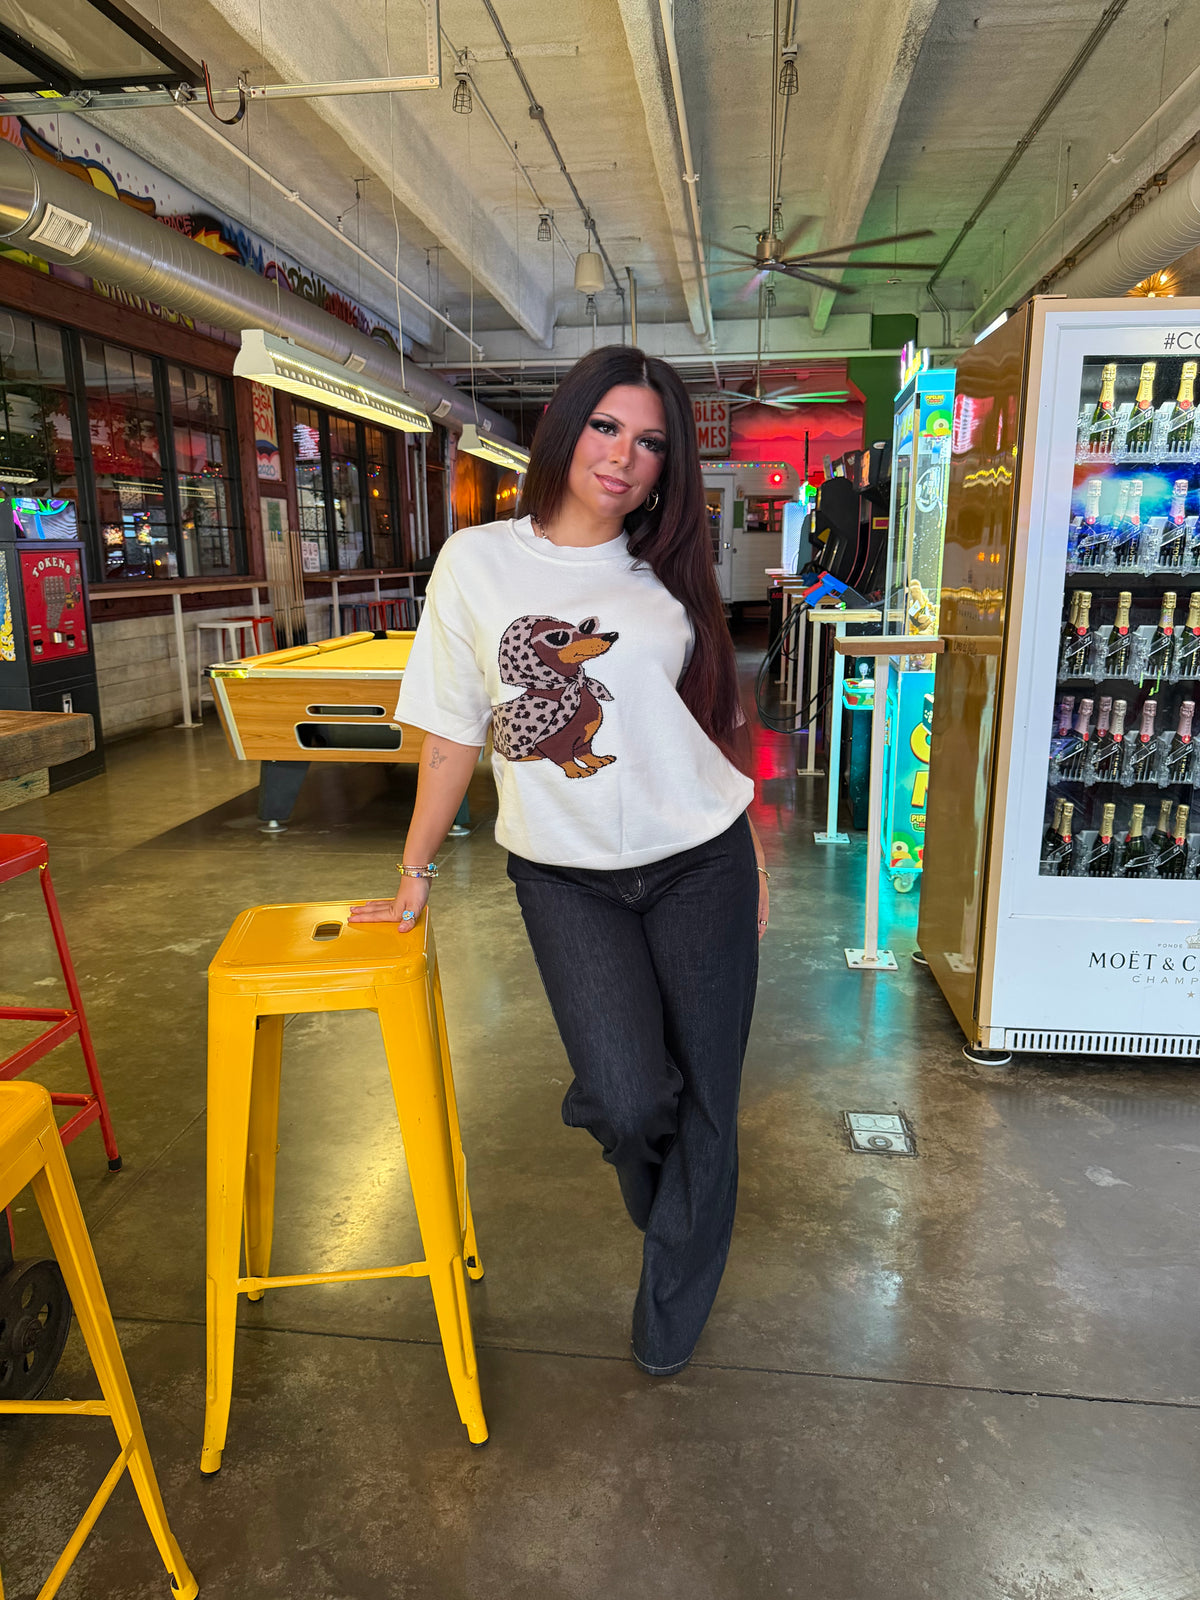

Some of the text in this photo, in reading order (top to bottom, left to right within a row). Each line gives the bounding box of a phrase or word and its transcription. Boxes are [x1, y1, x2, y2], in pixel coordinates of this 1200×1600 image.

[32, 558, 71, 578] TOKENS
[1088, 950, 1200, 972] MOËT & C
